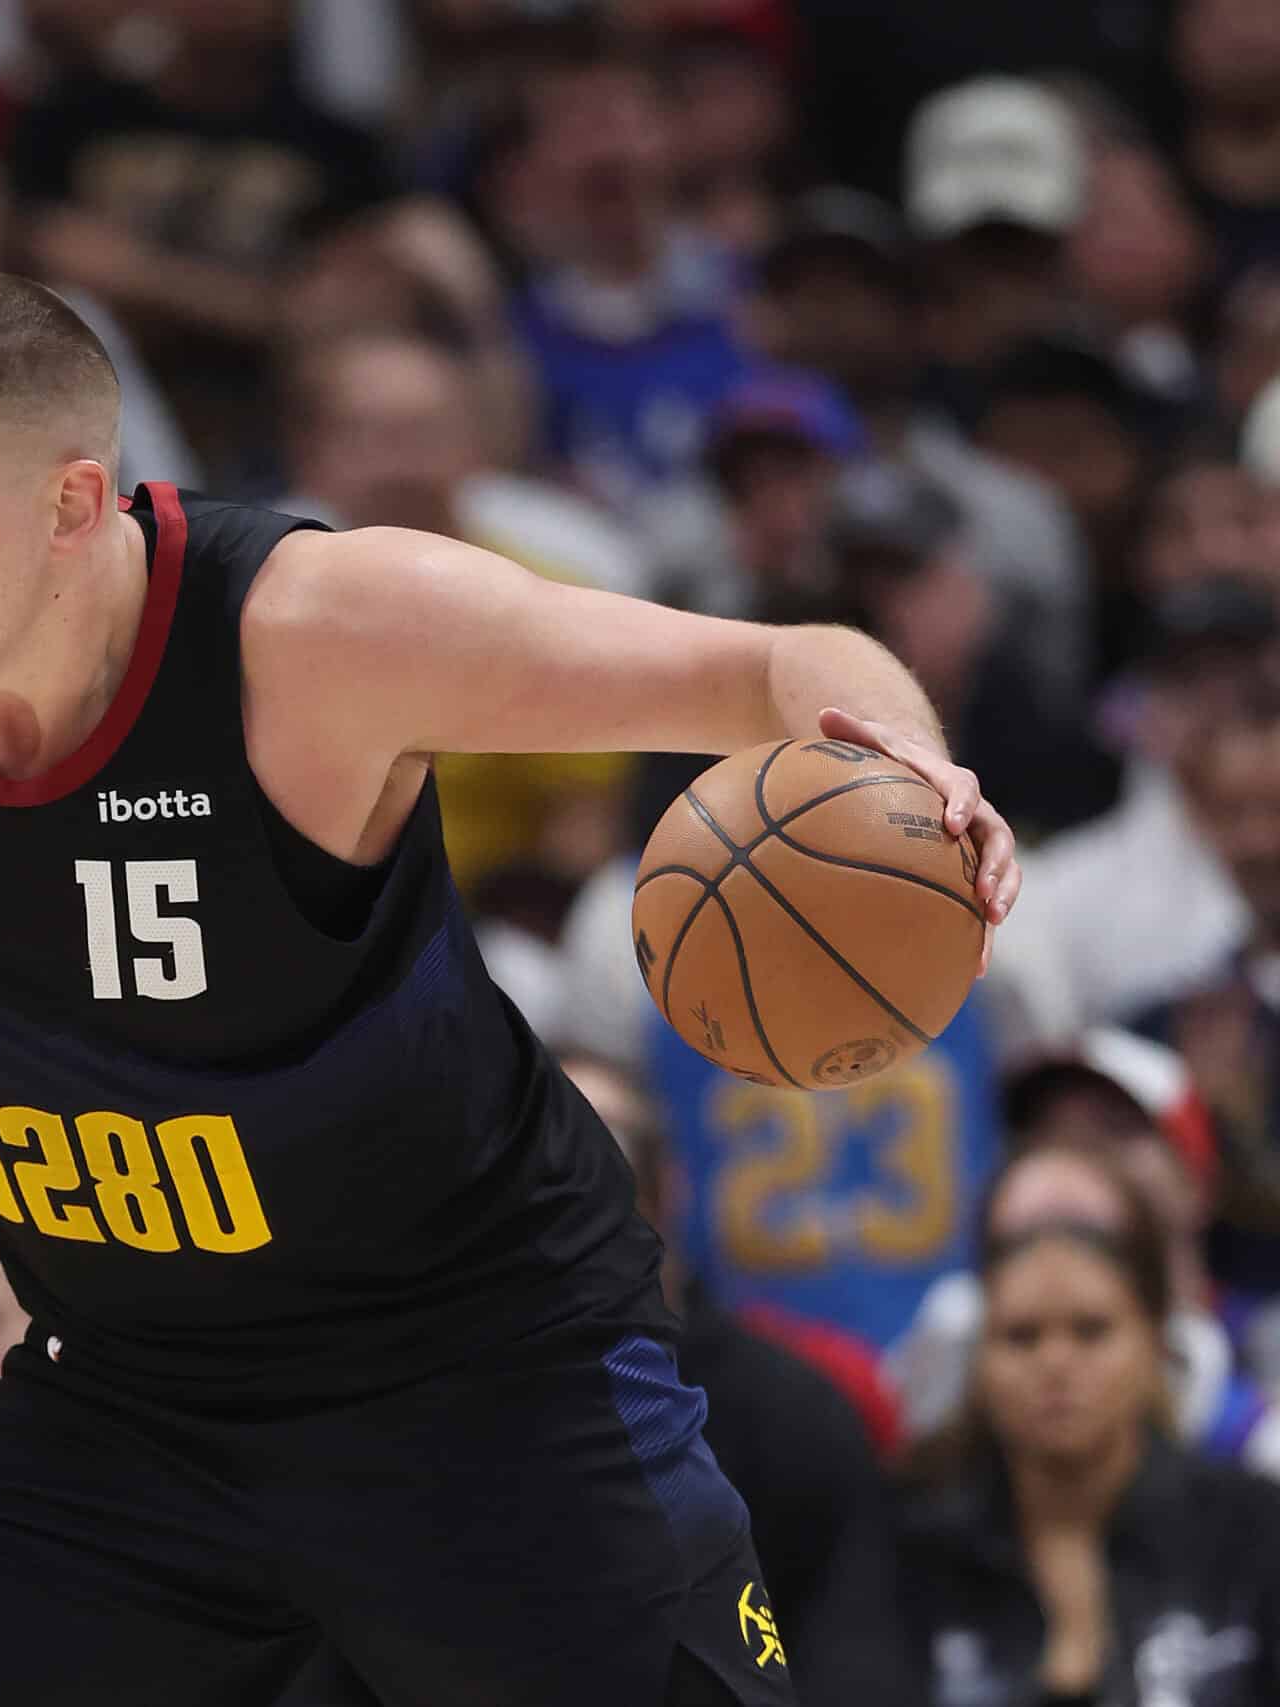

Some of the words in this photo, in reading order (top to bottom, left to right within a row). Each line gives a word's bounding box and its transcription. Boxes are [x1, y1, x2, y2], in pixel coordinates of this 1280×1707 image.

[98, 790, 211, 823] ibotta
[75, 859, 208, 1001] 15
[708, 1056, 957, 1269] 23
